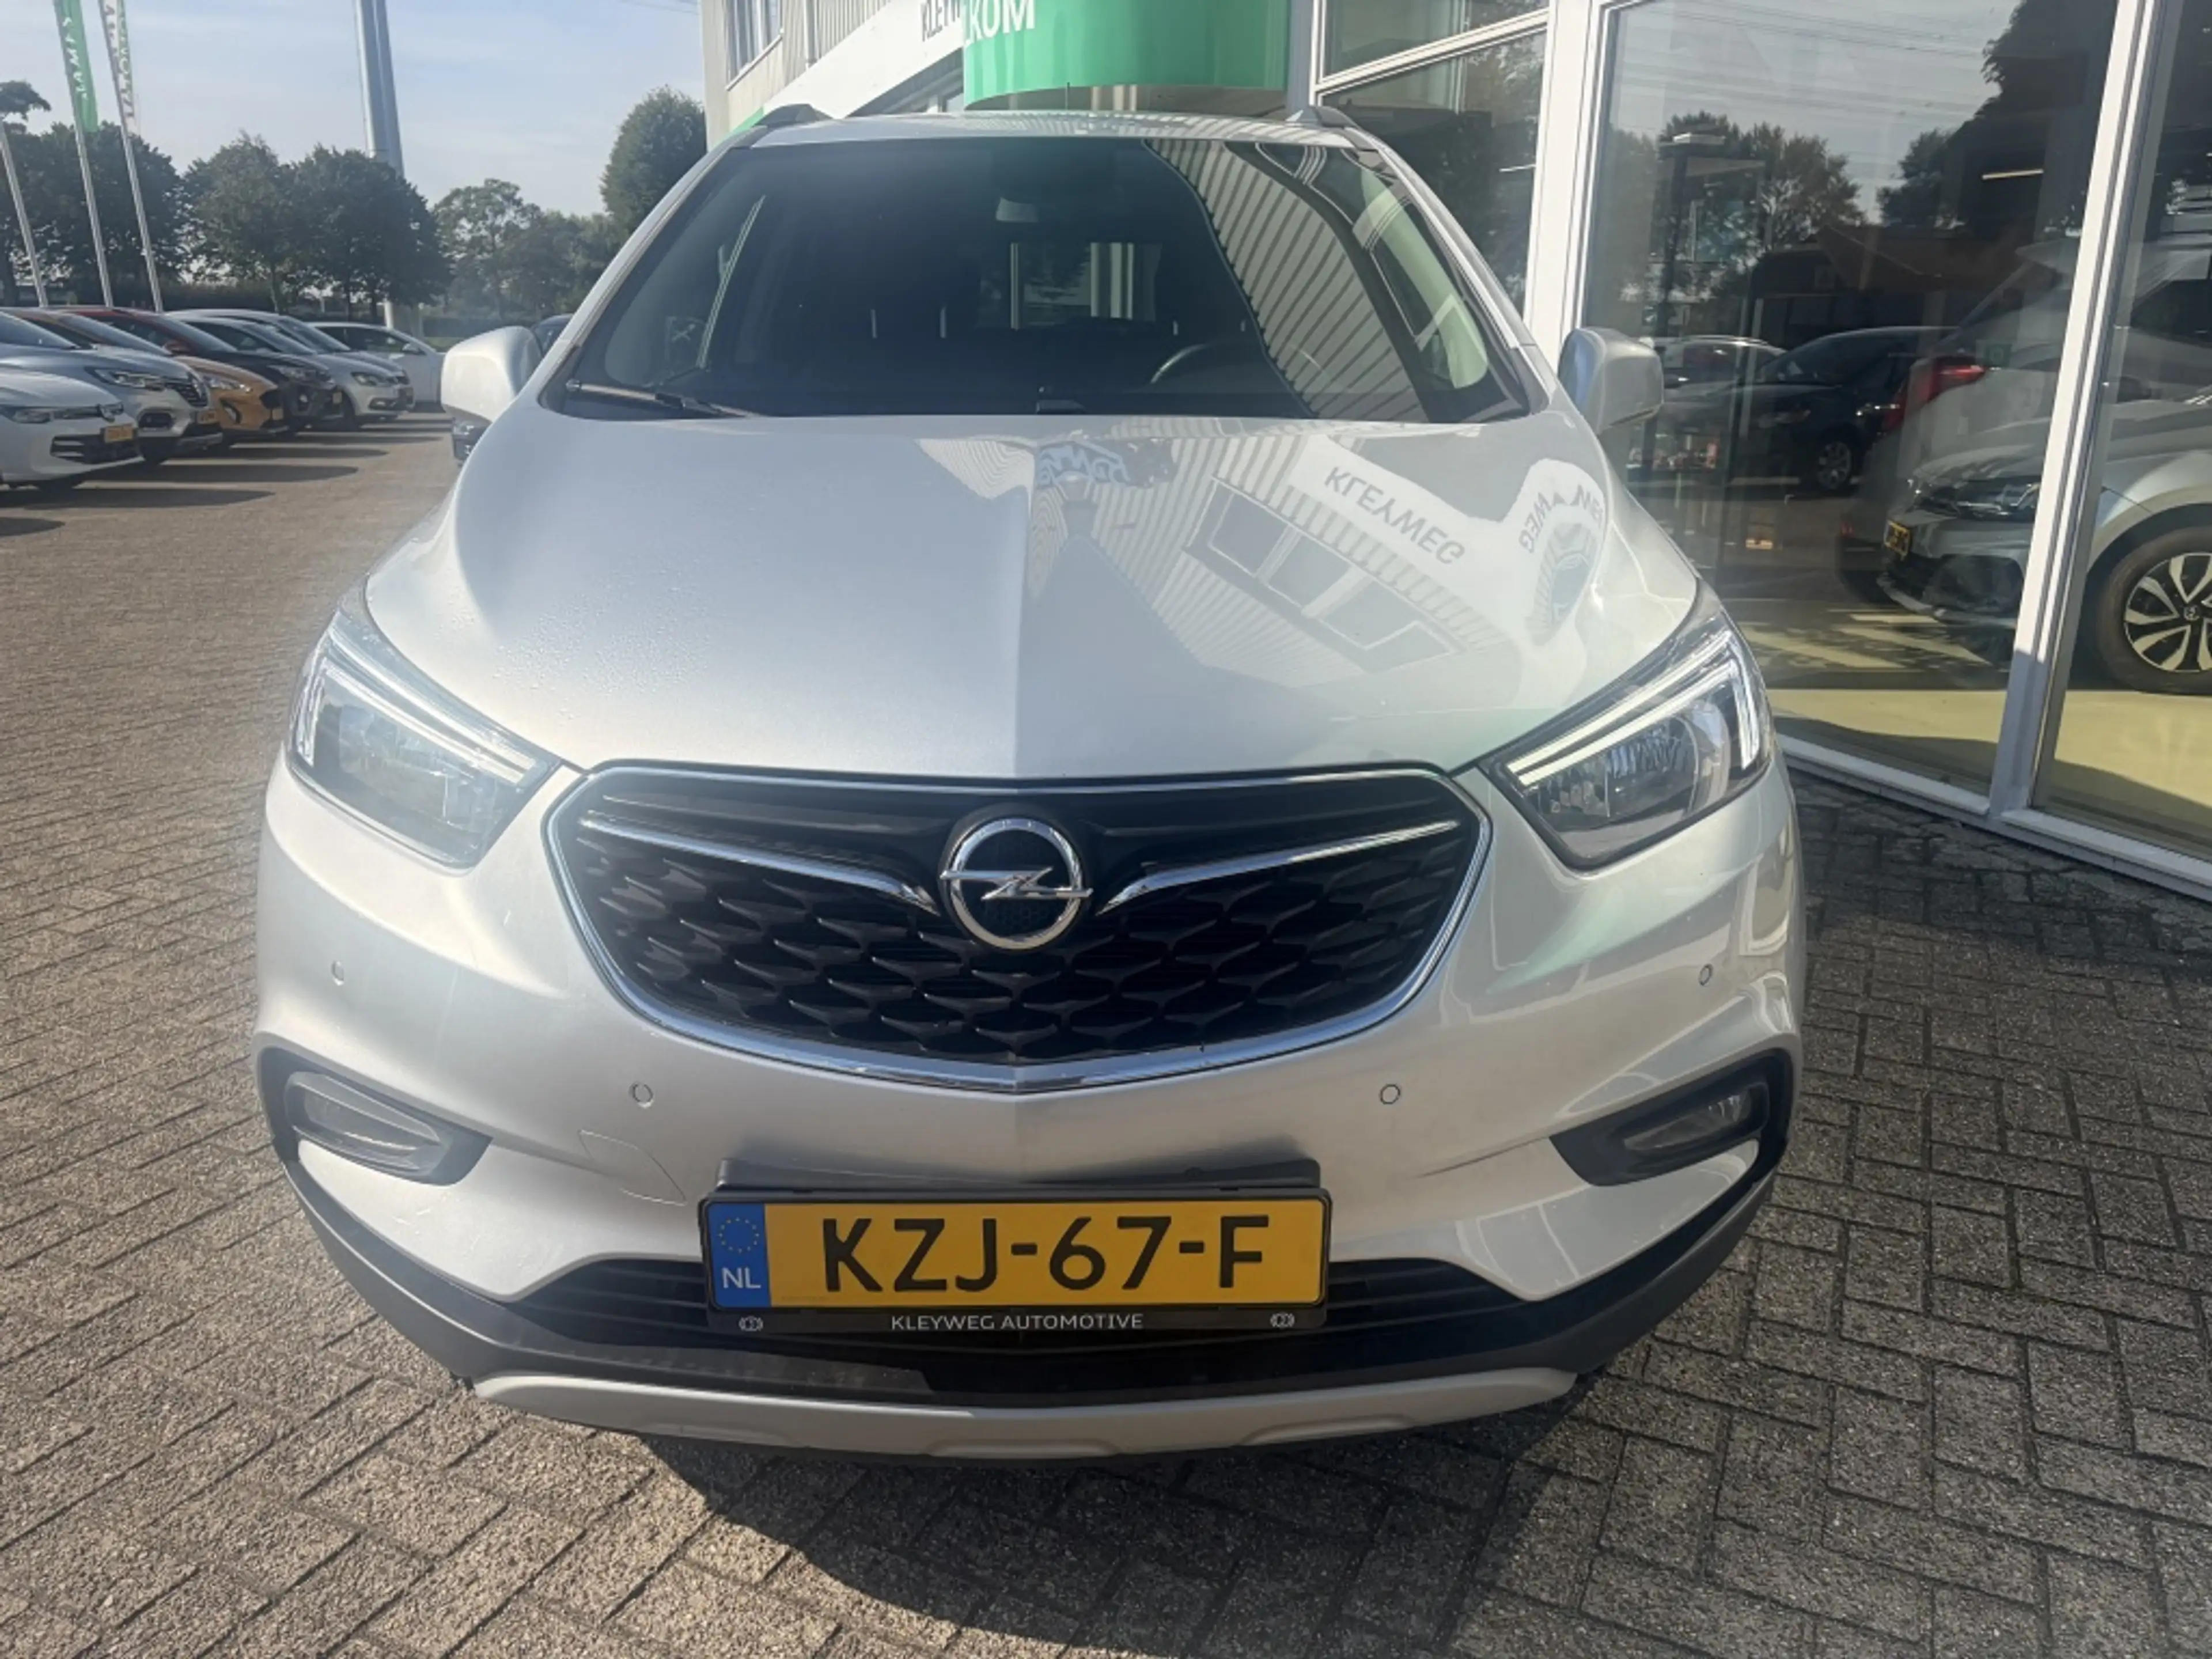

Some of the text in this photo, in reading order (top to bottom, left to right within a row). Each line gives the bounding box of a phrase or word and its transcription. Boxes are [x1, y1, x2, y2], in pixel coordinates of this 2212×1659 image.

[823, 1215, 1269, 1292] KZJ-67-F
[722, 1267, 761, 1289] NL
[891, 1313, 1143, 1331] KLEYWEG AUTOMOTIVE
